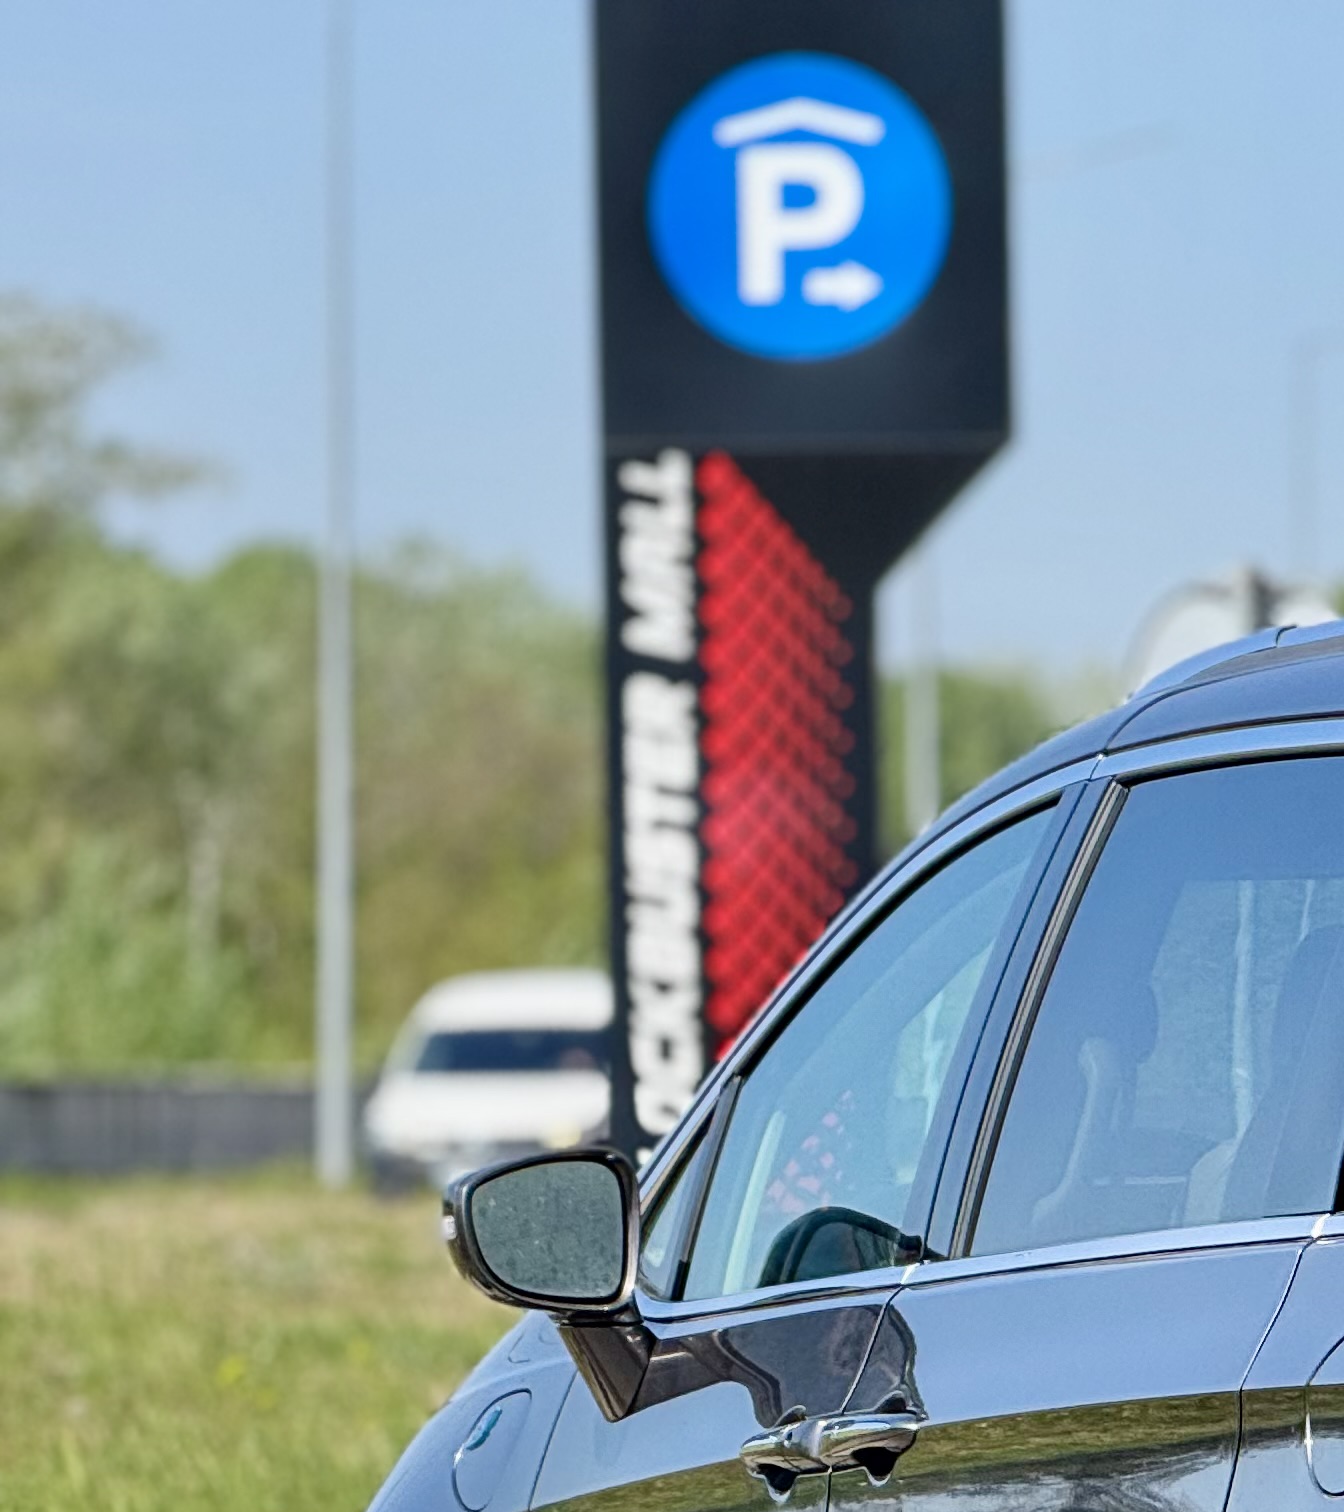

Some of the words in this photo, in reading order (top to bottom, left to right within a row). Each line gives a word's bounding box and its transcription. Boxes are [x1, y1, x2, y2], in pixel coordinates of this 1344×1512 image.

[735, 141, 866, 308] P
[619, 447, 696, 661] MALL
[622, 671, 699, 1166] OCKBUSTER
